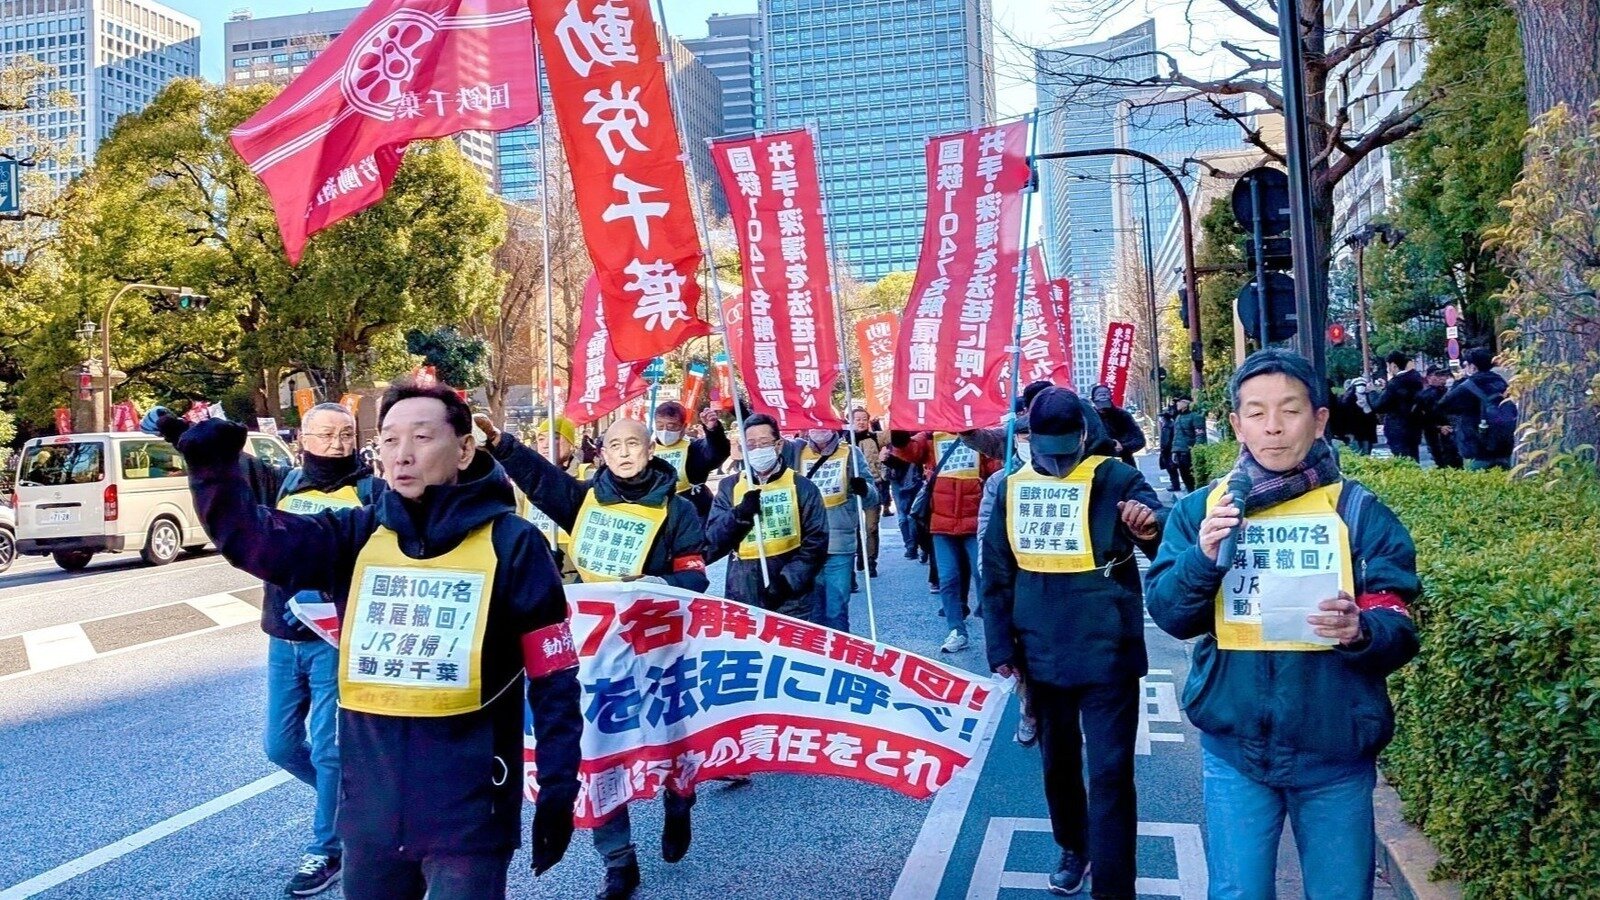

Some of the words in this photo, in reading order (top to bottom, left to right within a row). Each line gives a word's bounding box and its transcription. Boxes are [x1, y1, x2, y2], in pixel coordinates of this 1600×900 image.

[1019, 486, 1079, 500] 国鉄1047名
[1019, 503, 1079, 518] 解雇撤回!
[589, 511, 647, 535] 国鉄1047名
[1019, 521, 1076, 536] JR復帰!
[1019, 538, 1079, 551] 動労千葉
[372, 574, 472, 603] 国鉄1047名
[366, 601, 471, 631] 解雇撤回!
[1233, 599, 1262, 616] 動
[361, 631, 459, 658] JR復帰!
[570, 598, 991, 712] 7名解雇撤回!
[358, 656, 459, 682] 動労千葉
